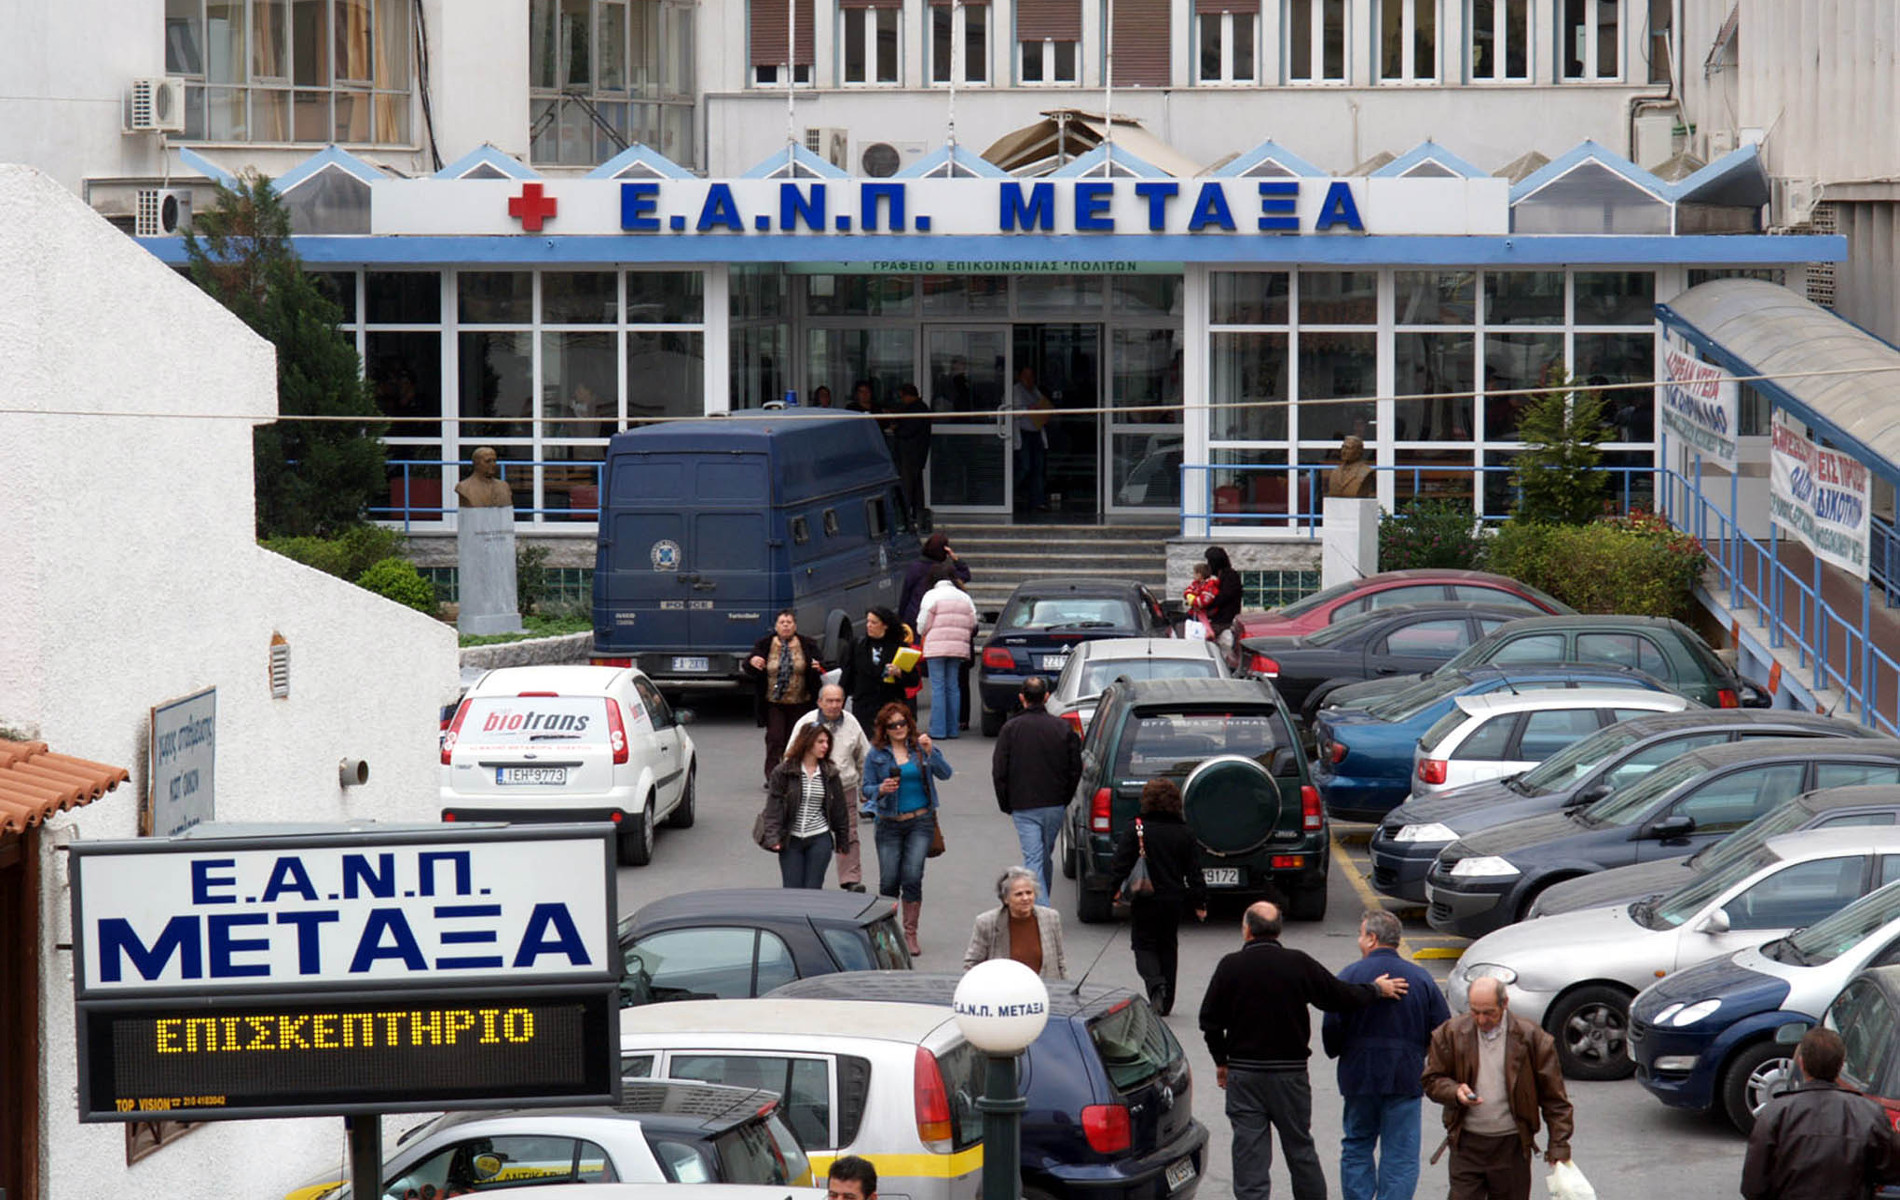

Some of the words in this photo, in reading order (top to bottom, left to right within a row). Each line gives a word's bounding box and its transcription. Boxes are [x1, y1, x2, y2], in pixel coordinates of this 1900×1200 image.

[621, 182, 931, 232] Ε.Α.Ν.Π.
[999, 181, 1365, 232] ΜΕΤΑΞΑ
[872, 260, 935, 271] ΓΡΑΦΕΙΟ
[946, 260, 1060, 271] ΕΠΙΚΟΙΝΩΝΙΑΣ
[483, 711, 590, 732] biotrans
[190, 850, 492, 905] Ε.Α.Ν.Π.
[97, 902, 593, 983] ΜΕΤΑΞΑ
[998, 1002, 1045, 1017] ΜΕΤΑΞΑ
[156, 1007, 535, 1054] ΕΠΙΣΚΕΠΤΗΡΙΟ
[115, 1098, 135, 1112] TOP
[138, 1097, 171, 1112] VISION
